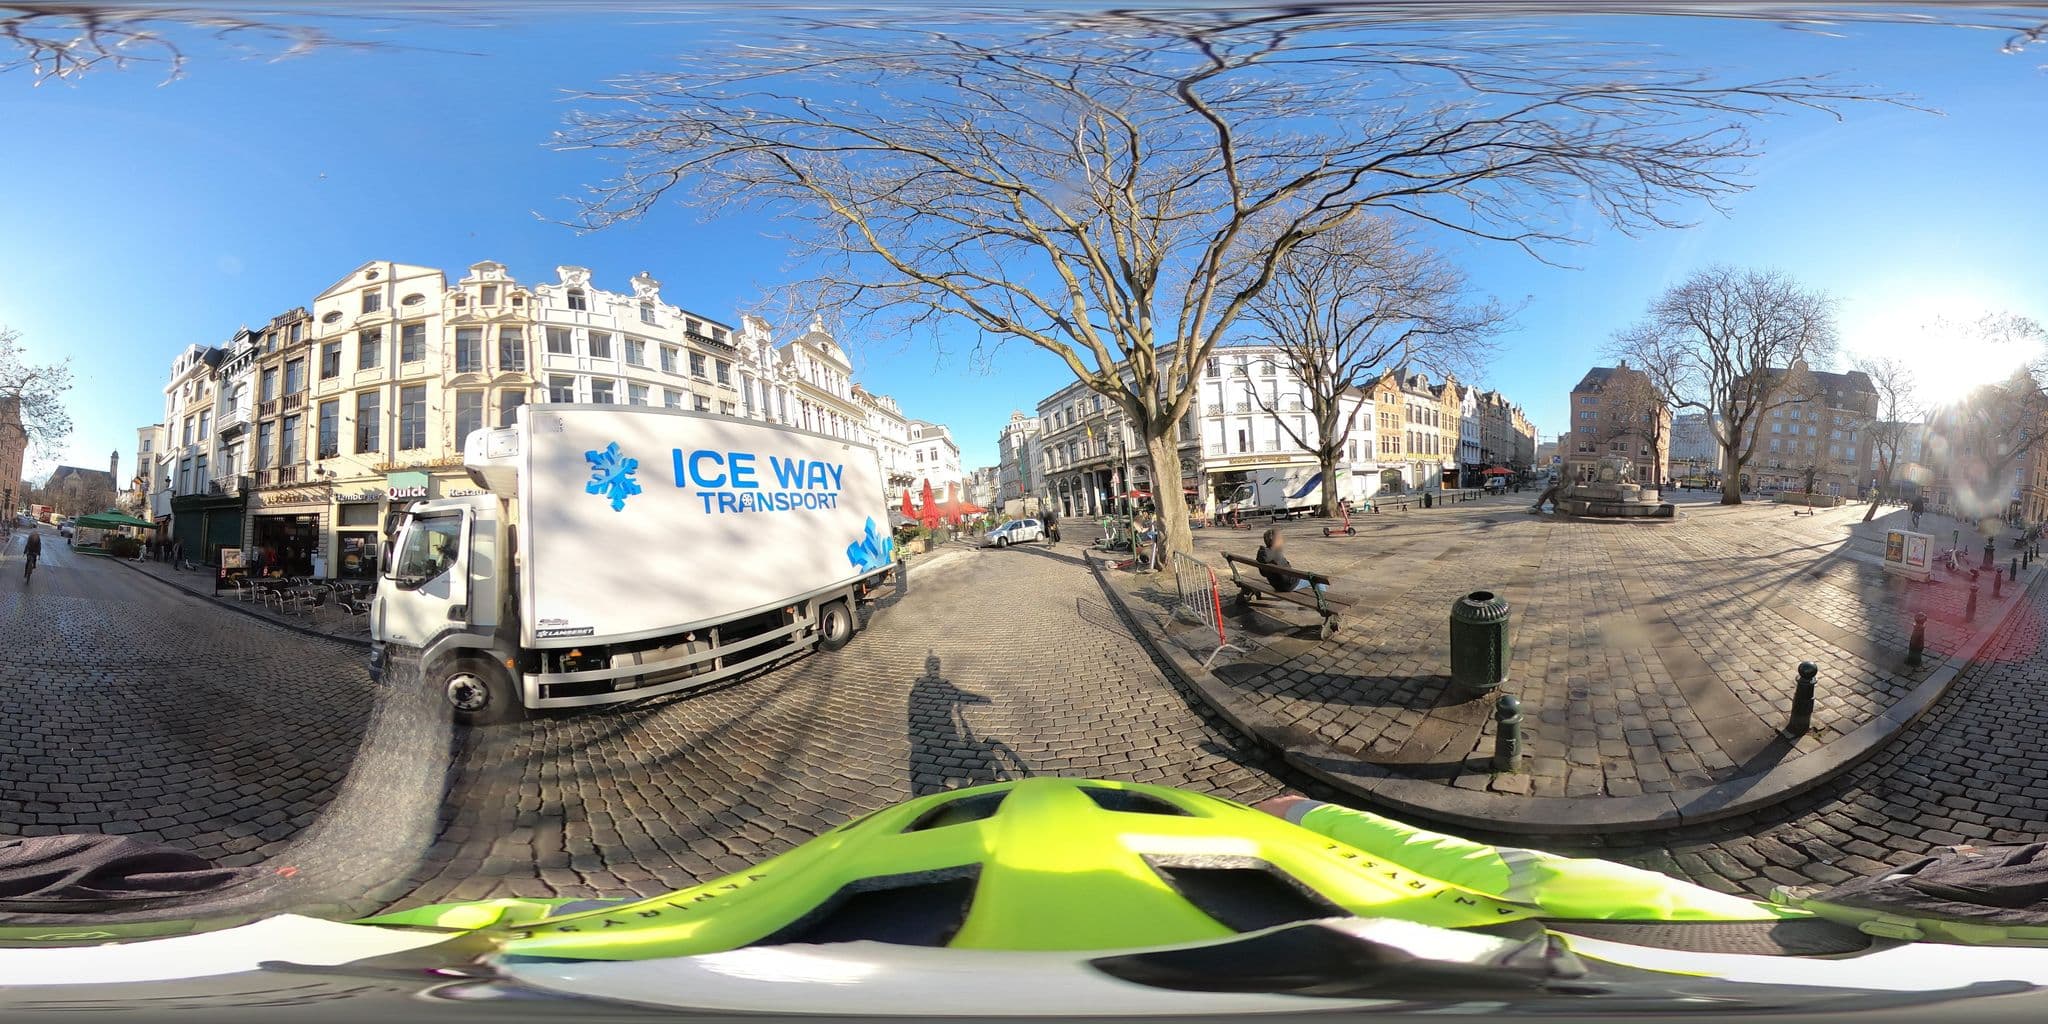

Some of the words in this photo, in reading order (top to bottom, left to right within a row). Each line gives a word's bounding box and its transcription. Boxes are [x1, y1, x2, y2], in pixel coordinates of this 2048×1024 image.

[672, 448, 759, 488] ICE
[769, 456, 843, 490] WAY
[388, 486, 426, 500] Quick
[696, 492, 838, 514] TRANSPORT
